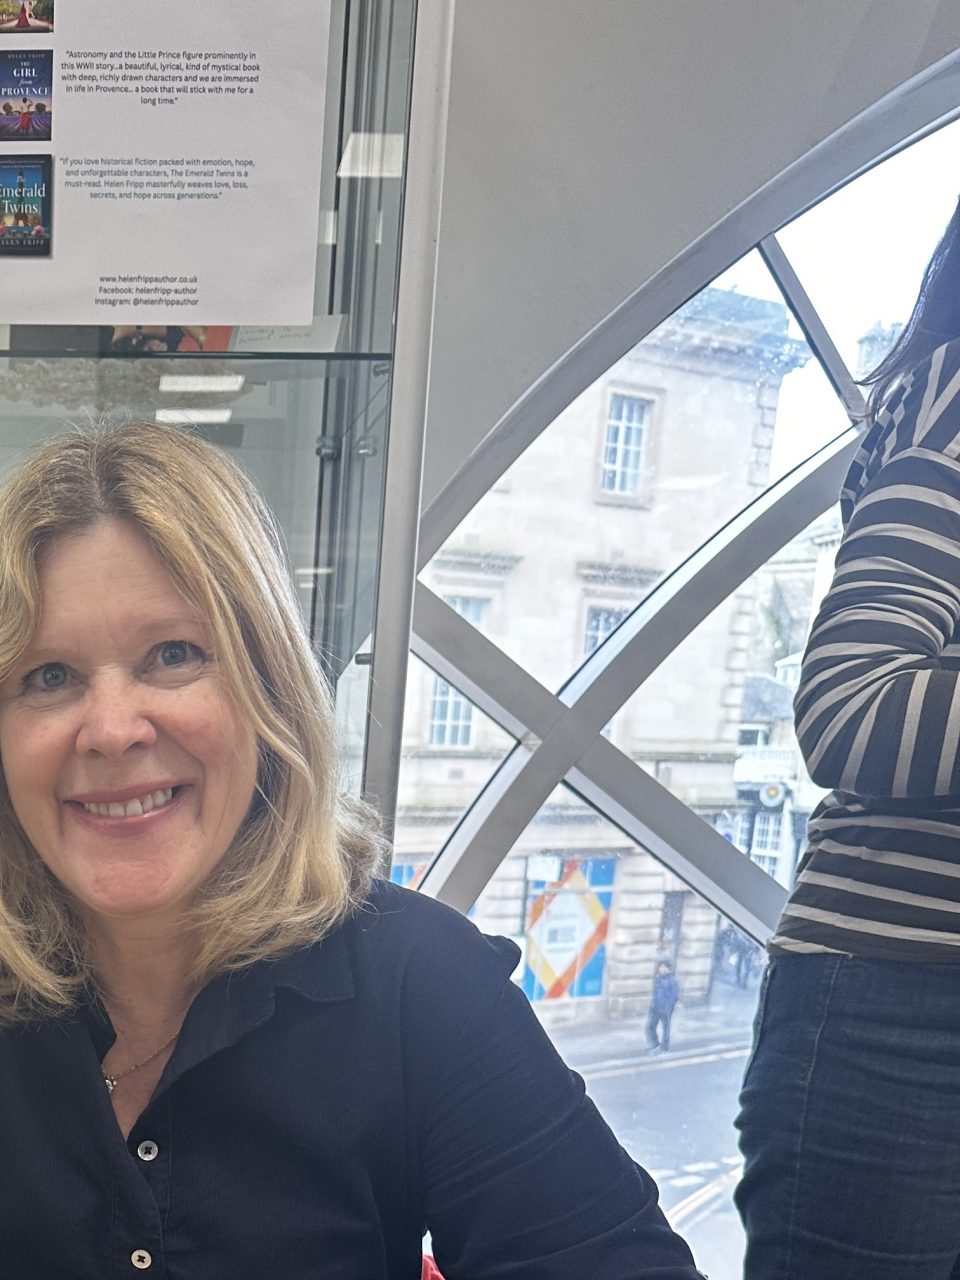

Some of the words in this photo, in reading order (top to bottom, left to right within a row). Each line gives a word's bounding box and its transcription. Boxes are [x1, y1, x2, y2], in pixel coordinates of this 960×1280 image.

[66, 51, 107, 61] "Astronomy
[138, 51, 156, 59] Little
[183, 52, 203, 61] figure
[205, 52, 247, 61] prominently
[13, 68, 38, 77] GIRL
[124, 63, 158, 71] beautiful,
[160, 63, 184, 73] lyrical,
[211, 63, 241, 73] mystical
[78, 74, 98, 83] deep,
[100, 74, 119, 83] richly
[184, 74, 197, 82] and
[1, 88, 49, 96] PROVENCE
[141, 97, 156, 106] long
[159, 158, 184, 168] packed
[202, 159, 233, 167] emotion,
[235, 159, 255, 168] hope,
[80, 169, 128, 179] unforgettable
[130, 170, 169, 178] characters,
[104, 180, 124, 188] Helen
[126, 180, 144, 190] Fripp
[145, 181, 185, 190] masterfully
[214, 181, 231, 189] love,
[232, 181, 248, 189] loss,
[90, 192, 117, 200] secrets,
[133, 192, 151, 202] hope
[177, 192, 222, 202] generations."
[2, 200, 38, 213] Twins
[135, 287, 197, 295] helenfripp-author
[95, 298, 131, 306] Instagram:
[133, 298, 198, 306] @helenfrippauthor
